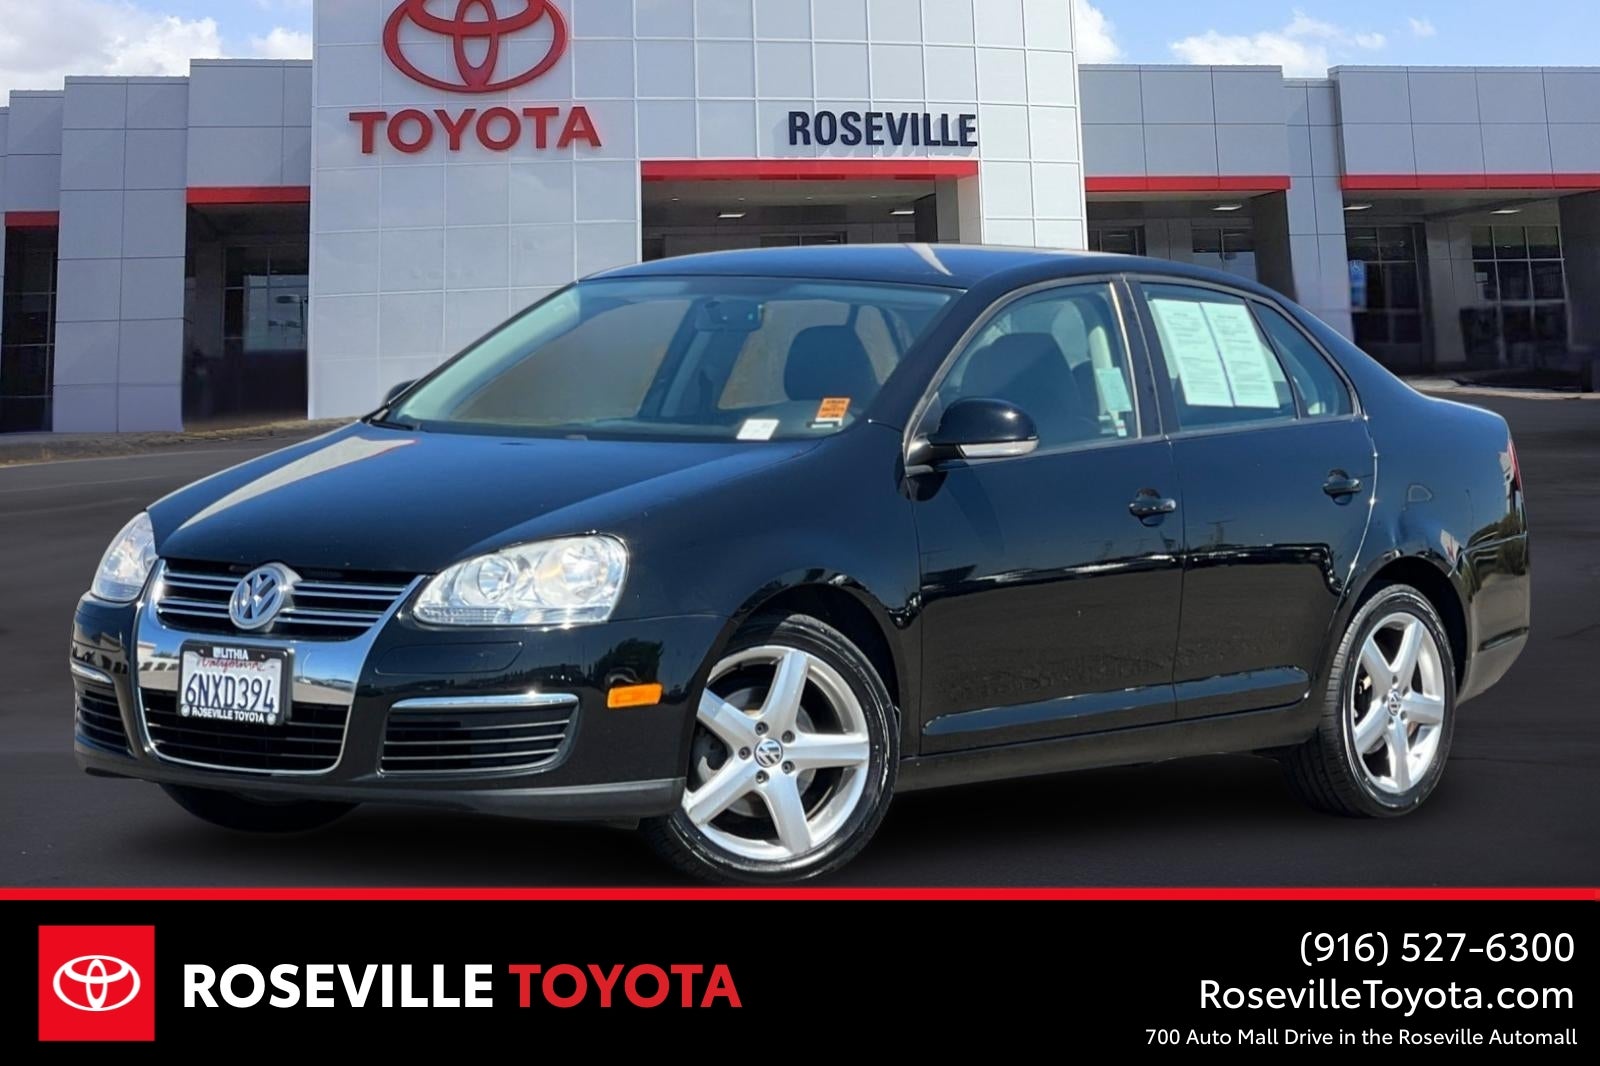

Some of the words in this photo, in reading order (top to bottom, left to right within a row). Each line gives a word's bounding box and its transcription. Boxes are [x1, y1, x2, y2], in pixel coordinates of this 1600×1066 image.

[350, 105, 602, 154] TOYOTA
[788, 110, 979, 148] ROSEVILLE
[221, 647, 249, 660] LITHIA
[184, 672, 276, 714] 6NXD394
[191, 706, 234, 720] ROSEVILLE
[234, 711, 265, 723] TOYOTA
